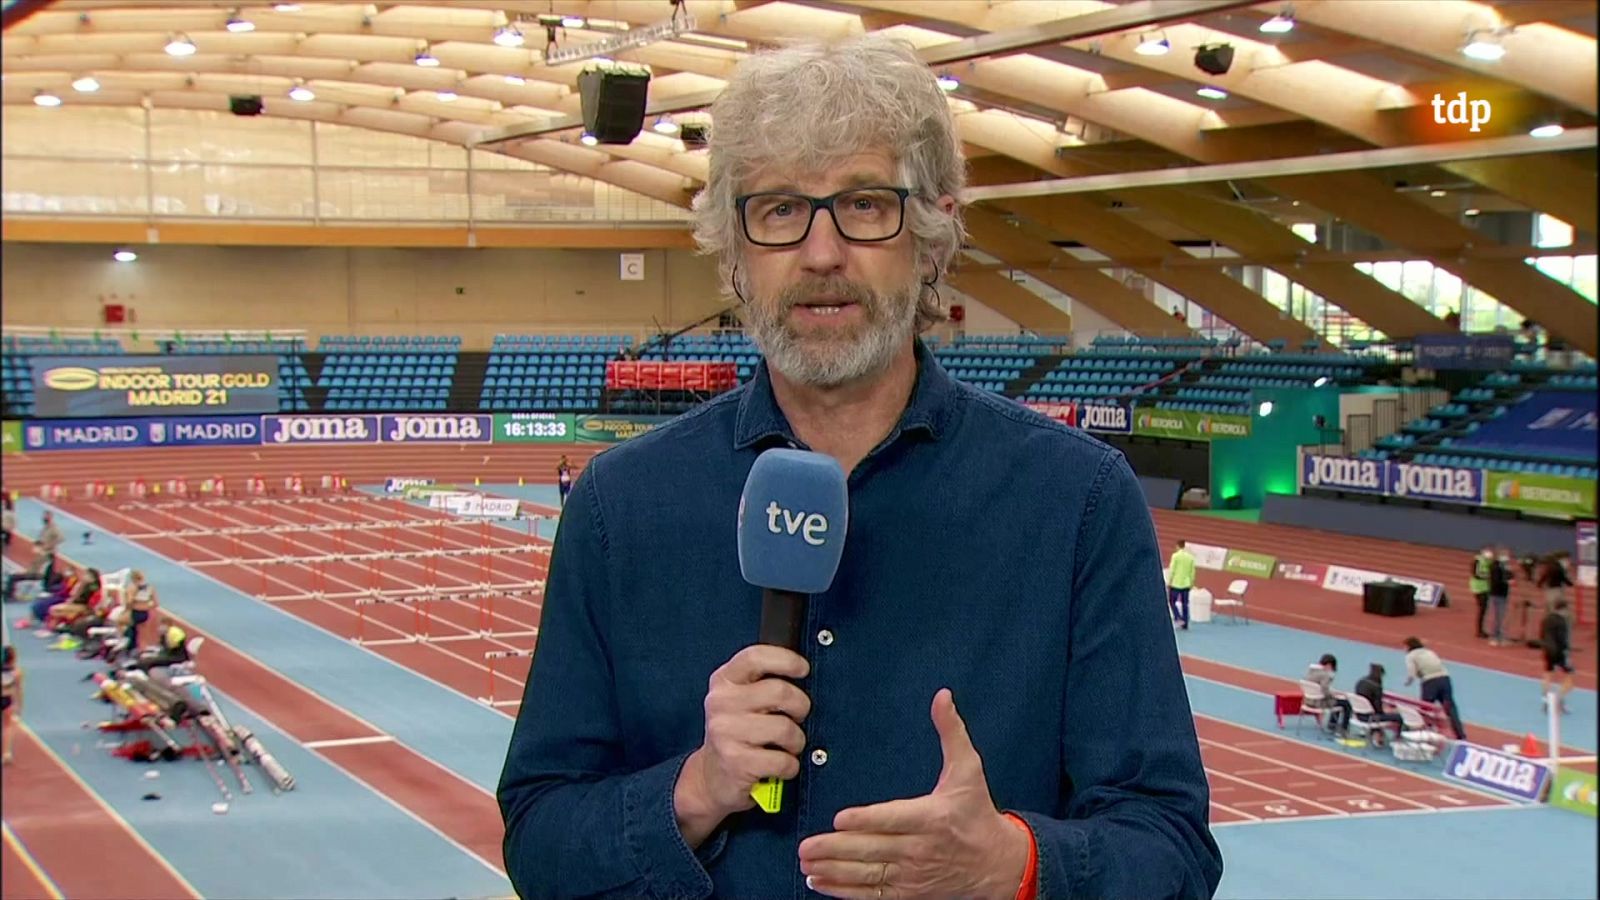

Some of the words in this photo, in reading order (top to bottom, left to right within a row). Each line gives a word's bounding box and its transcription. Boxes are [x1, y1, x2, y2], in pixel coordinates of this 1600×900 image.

[627, 263, 638, 275] C
[99, 374, 171, 389] INDOOR
[173, 374, 221, 388] TOUR
[221, 373, 270, 388] GOLD
[127, 390, 202, 405] MADRID
[205, 389, 227, 405] 21
[53, 425, 139, 443] MADRID
[175, 423, 257, 440] MADRID
[503, 422, 567, 437] 16:13:33
[766, 501, 828, 545] tve
